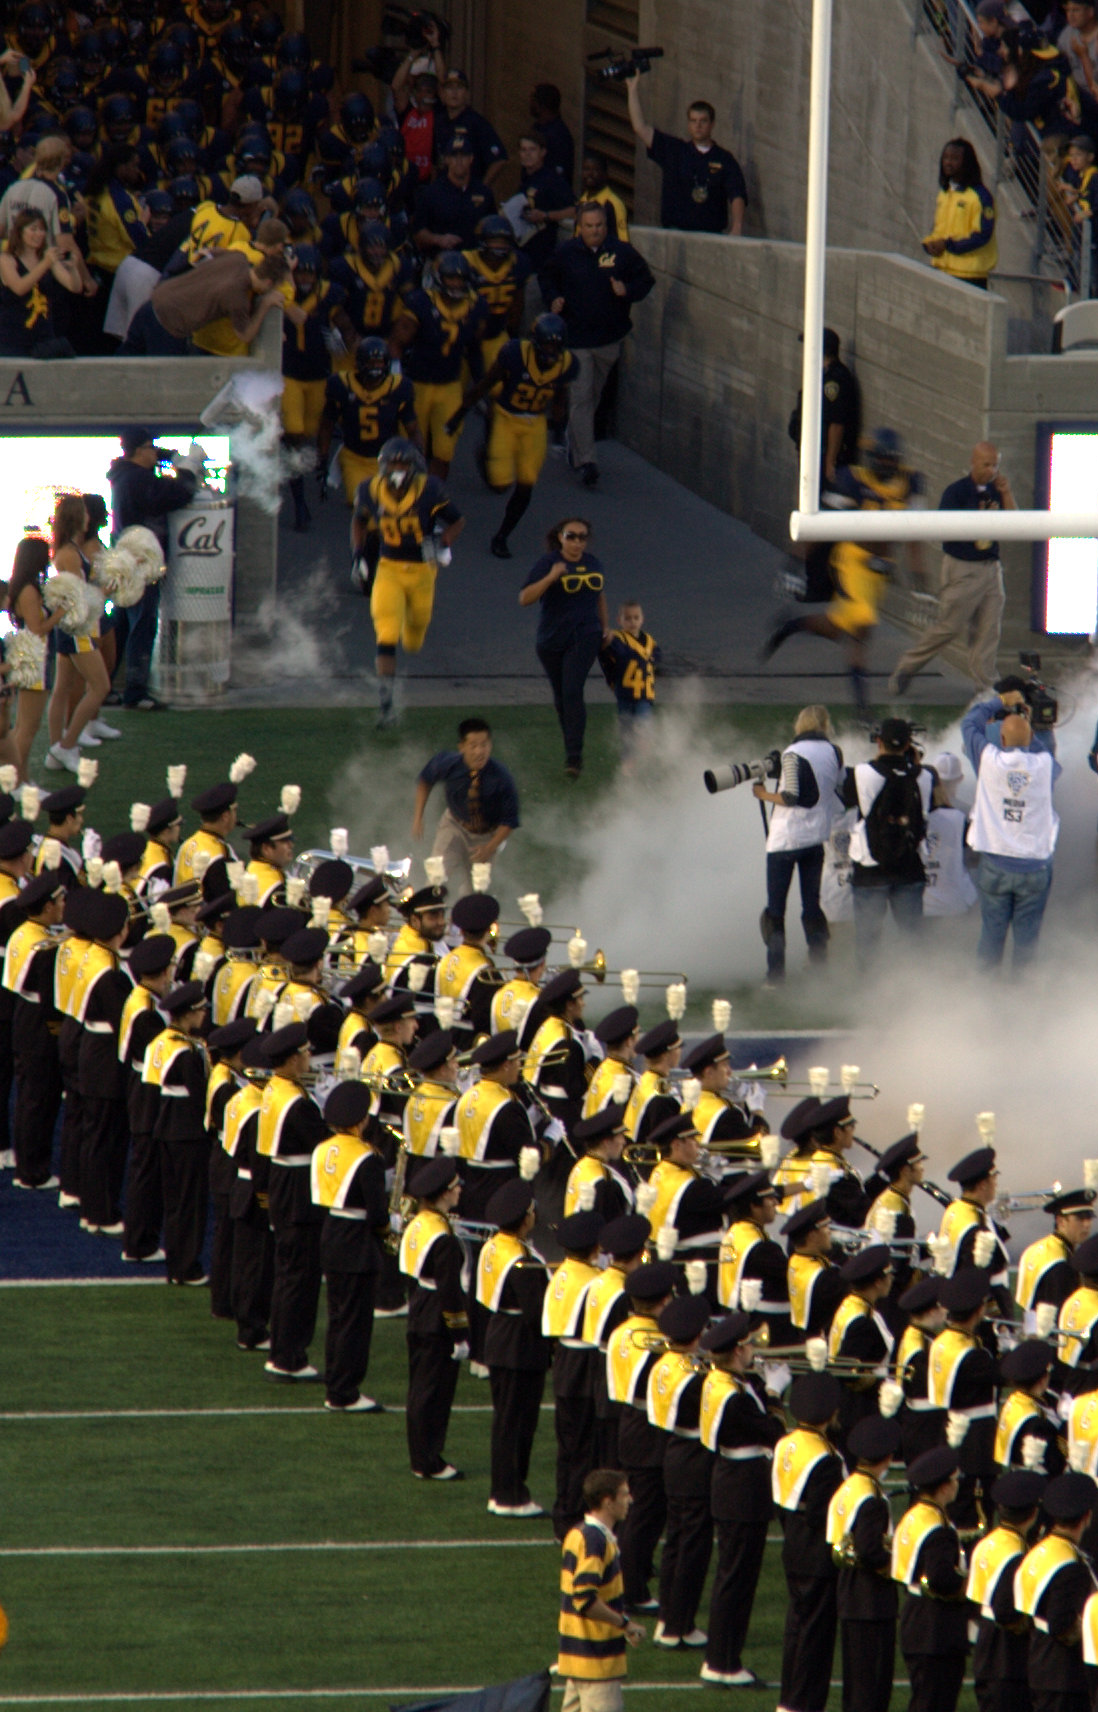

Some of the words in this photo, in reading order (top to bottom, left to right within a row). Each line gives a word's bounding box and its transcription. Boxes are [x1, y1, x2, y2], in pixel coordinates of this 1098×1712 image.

[598, 250, 617, 268] Cal
[441, 321, 461, 357] 7
[5, 372, 34, 405] A
[358, 405, 380, 440] 5
[178, 517, 225, 556] Cal
[1003, 798, 1026, 807] MEDIA
[1004, 808, 1024, 823] 153
[446, 955, 460, 982] C
[501, 990, 514, 1018] C
[153, 1039, 165, 1069] C
[415, 1094, 427, 1122] C
[466, 1090, 480, 1119] C
[325, 1145, 340, 1174] C
[485, 1243, 498, 1274] C
[555, 1270, 569, 1301] C
[657, 1365, 670, 1395] C
[784, 1442, 798, 1472] C
